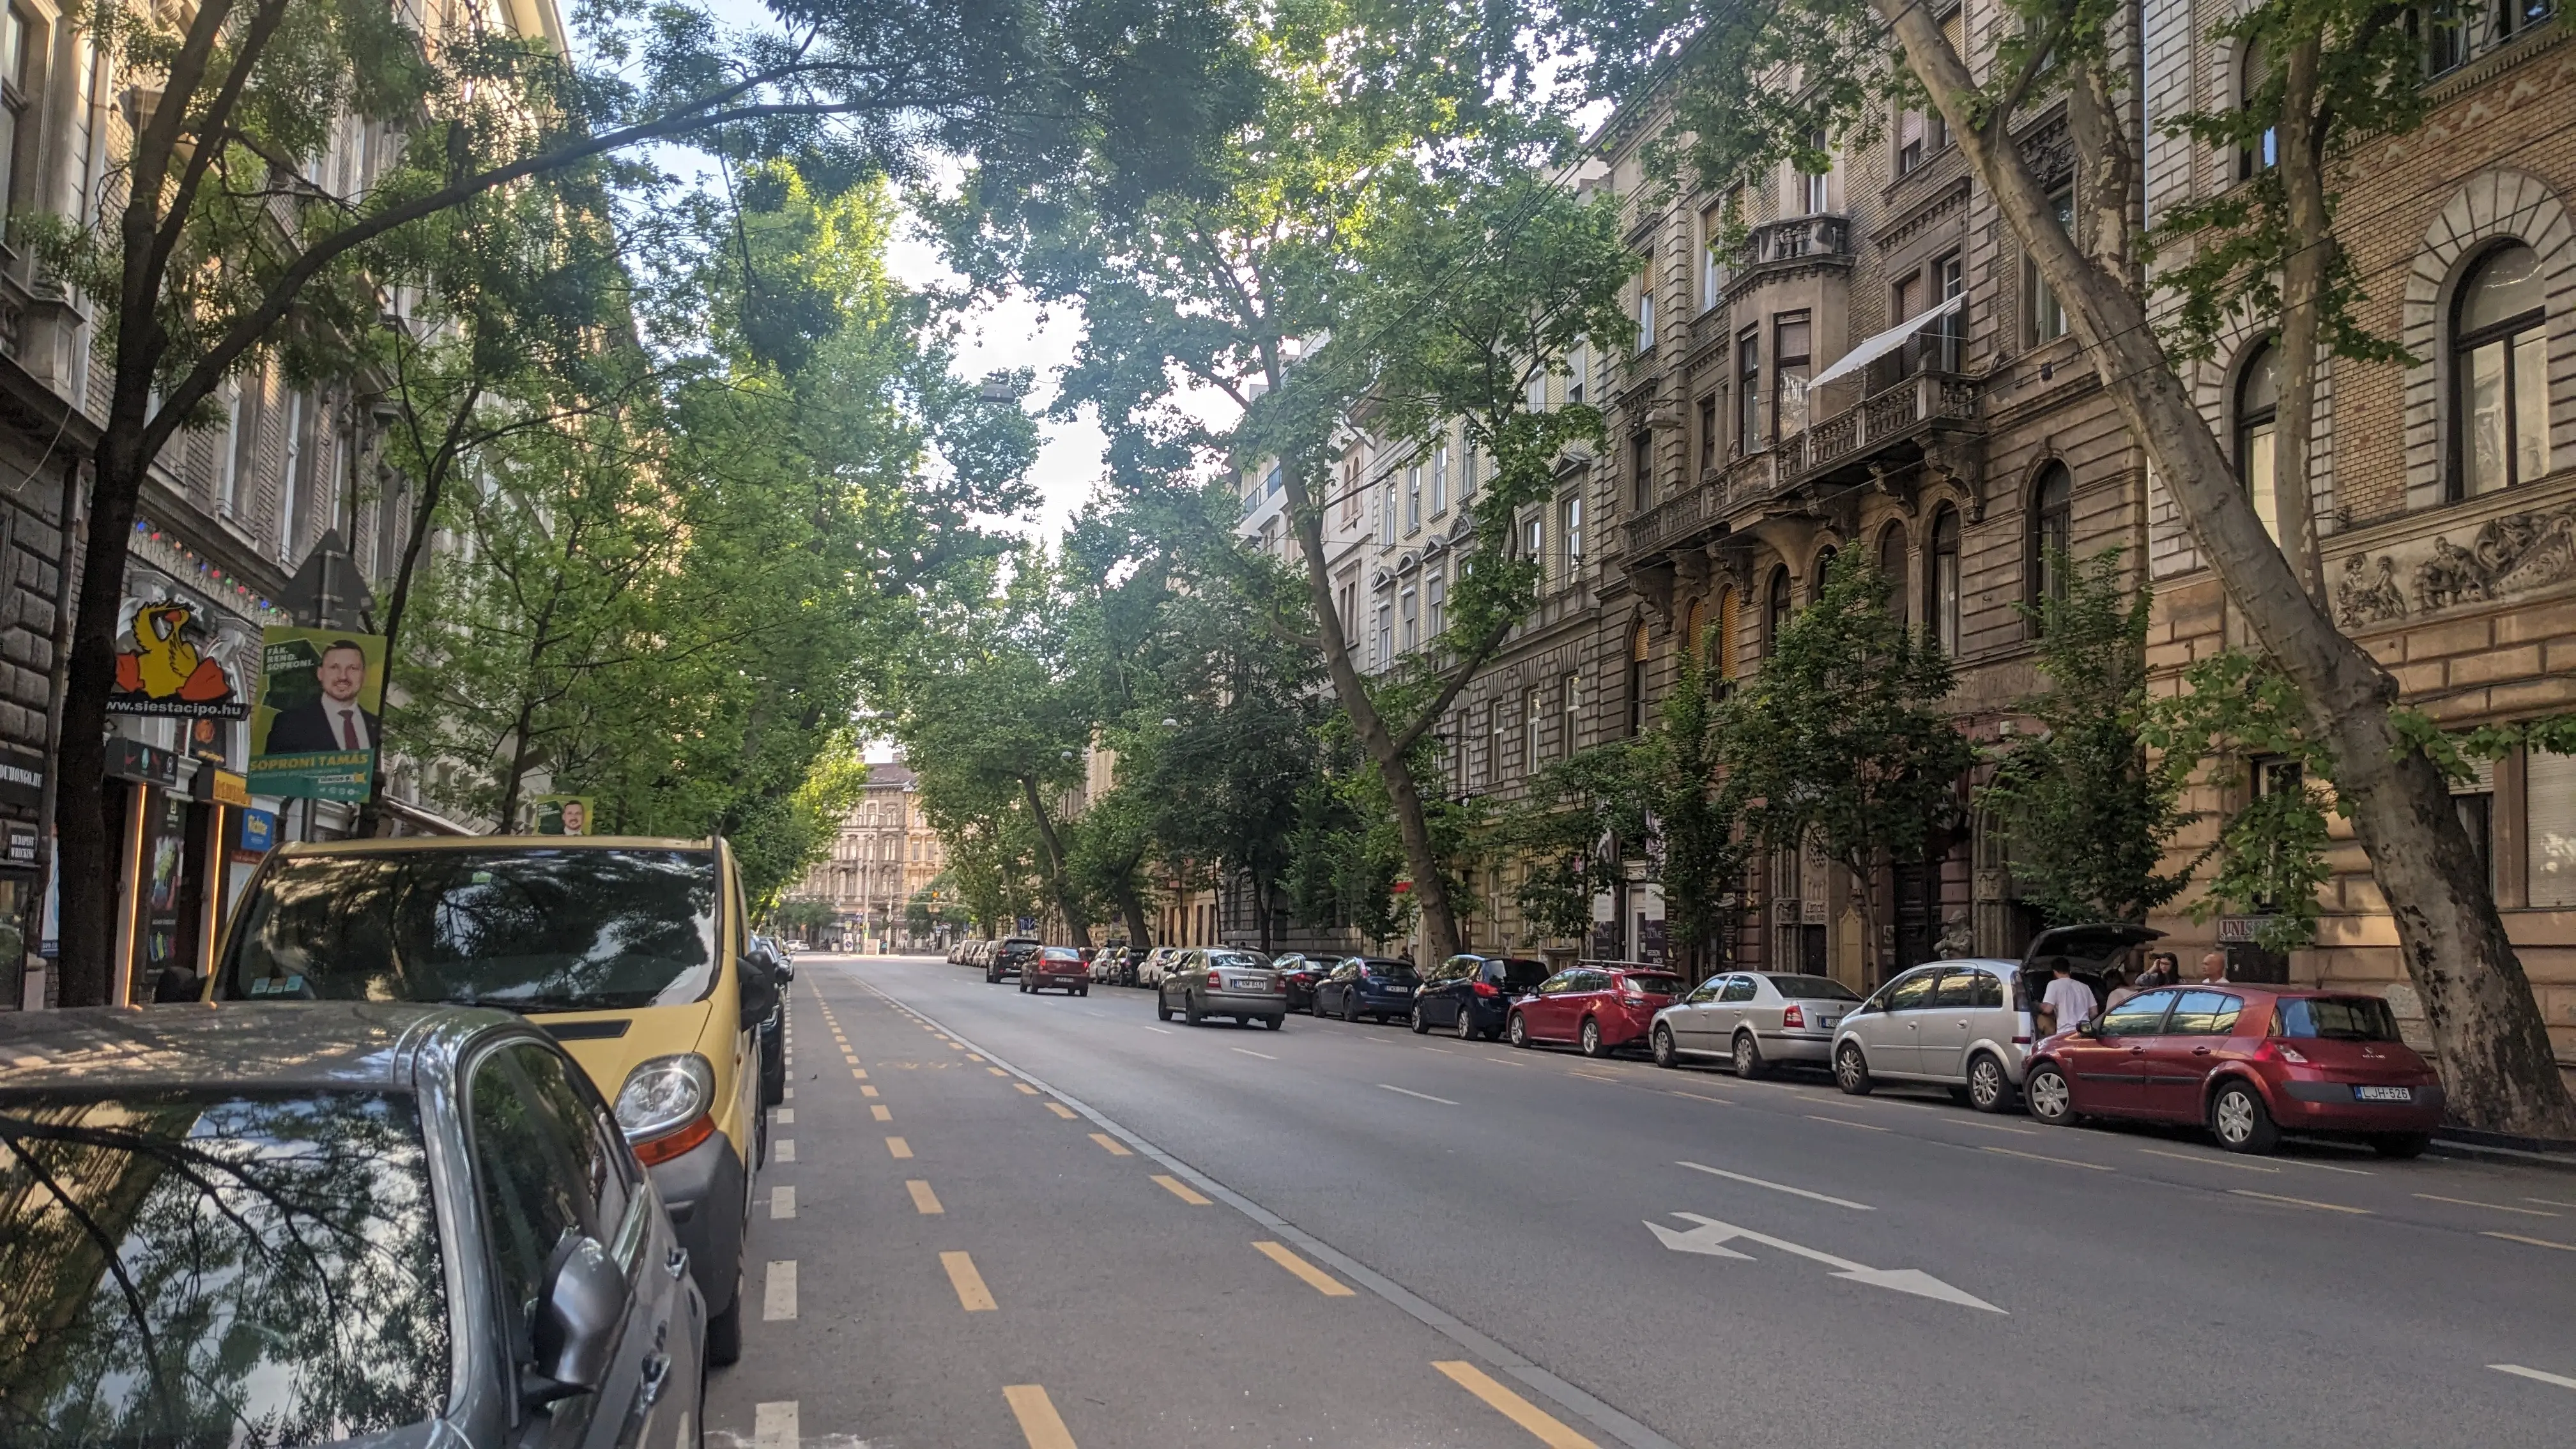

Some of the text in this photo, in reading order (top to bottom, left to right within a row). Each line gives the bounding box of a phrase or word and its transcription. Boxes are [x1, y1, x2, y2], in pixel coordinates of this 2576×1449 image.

[266, 654, 297, 663] REND.
[266, 659, 314, 671] SOPRONI.
[250, 753, 369, 770] SOPRONI TAMÁS
[2363, 1087, 2409, 1099] LJH-526
